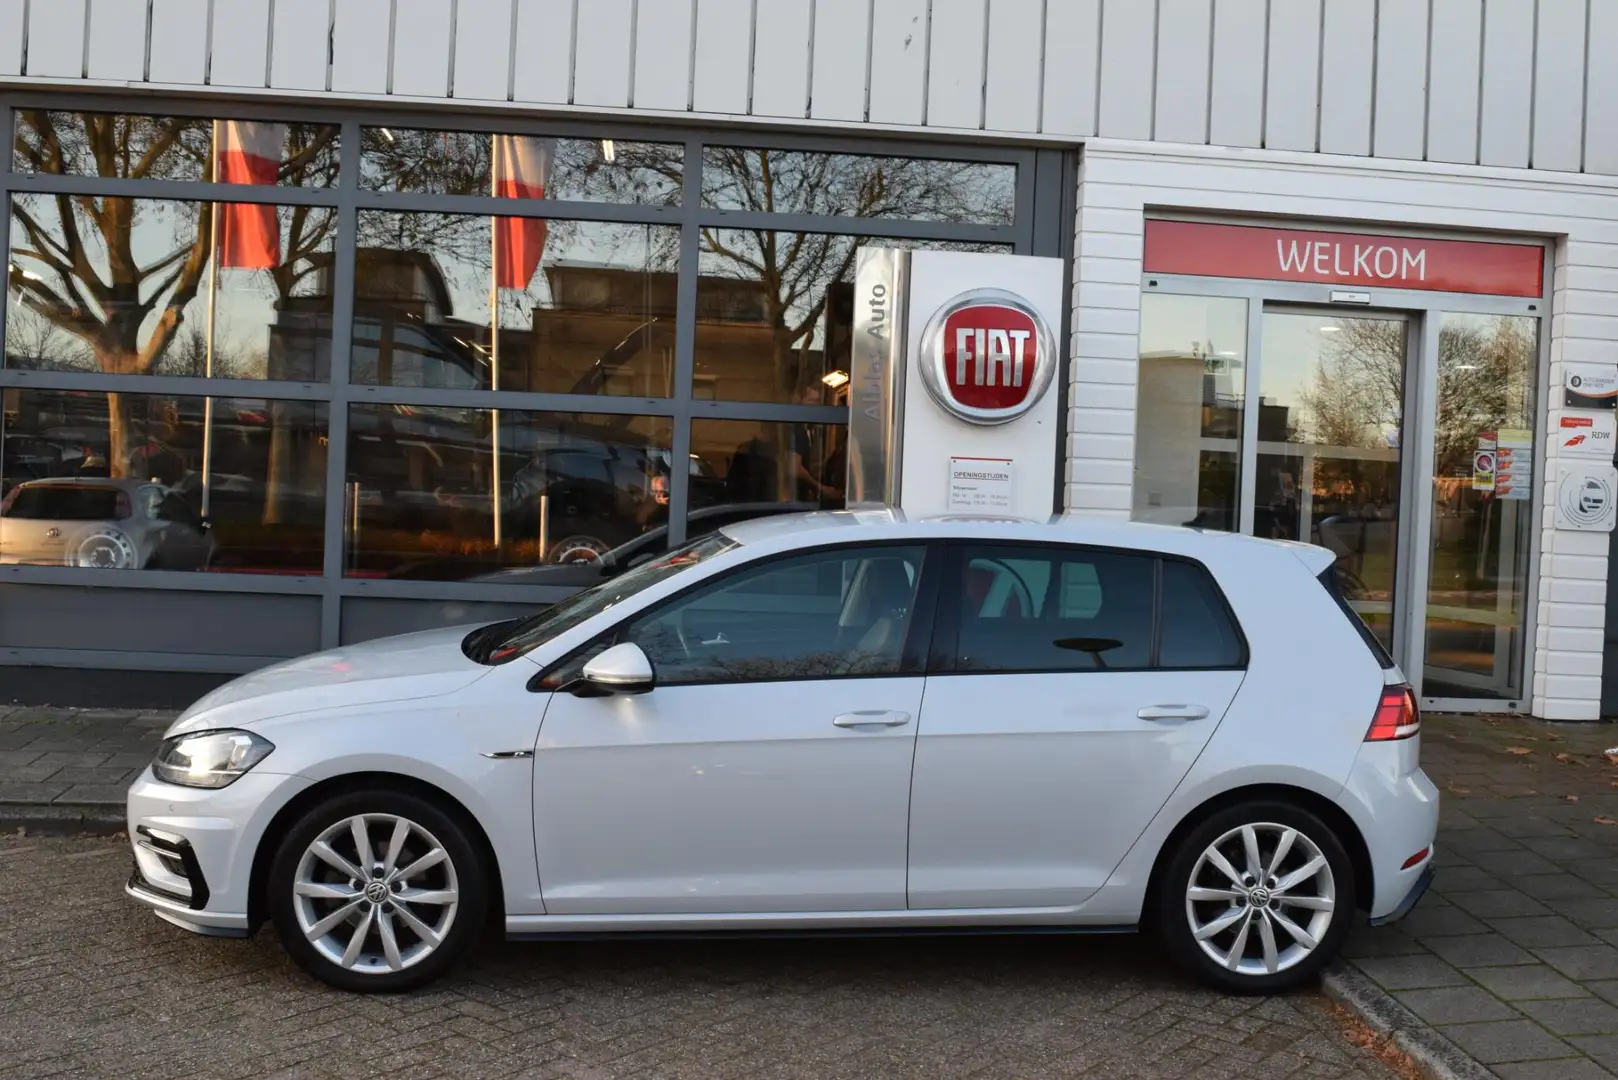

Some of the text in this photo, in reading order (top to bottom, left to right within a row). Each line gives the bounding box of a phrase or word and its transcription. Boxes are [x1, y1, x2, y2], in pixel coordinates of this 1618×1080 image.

[1277, 239, 1426, 281] WELKOM
[867, 284, 886, 340] Auto
[956, 327, 1030, 387] FIAT
[1591, 431, 1611, 439] RDW
[953, 471, 1009, 479] OPENINGSTIJDEN
